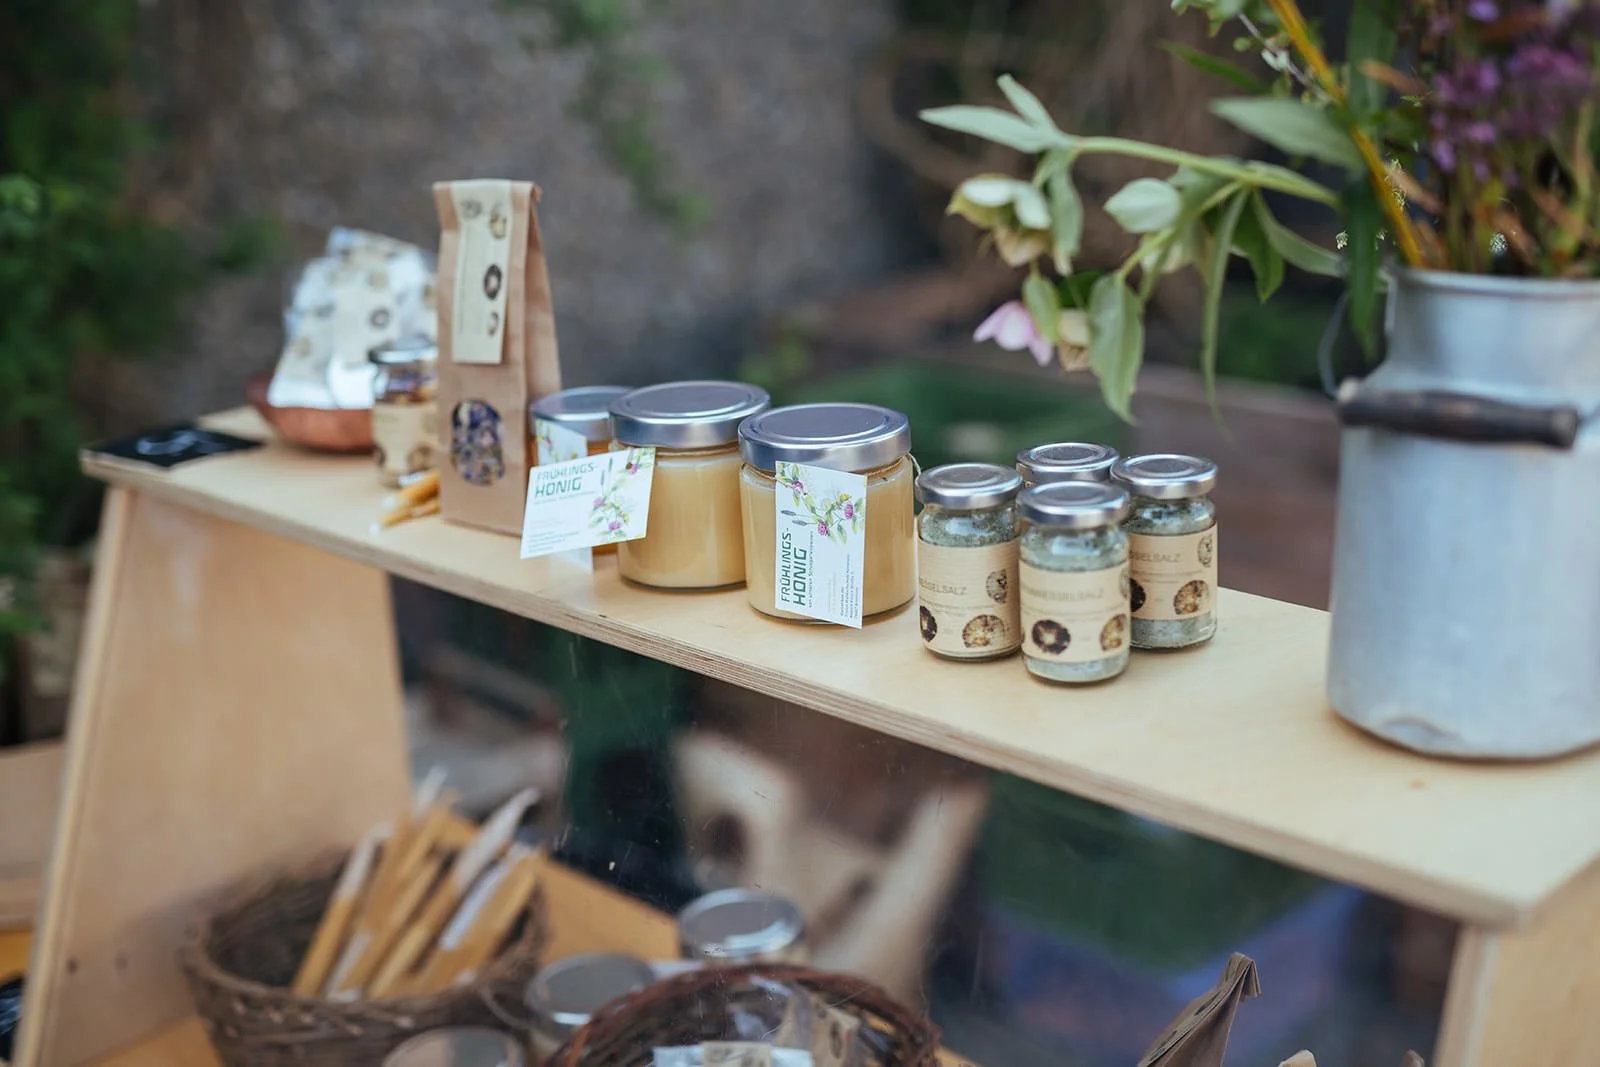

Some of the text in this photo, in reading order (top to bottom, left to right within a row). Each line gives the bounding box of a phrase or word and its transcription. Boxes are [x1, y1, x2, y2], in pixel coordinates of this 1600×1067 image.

[535, 476, 583, 498] HONIG
[780, 527, 792, 603] FRÜHLINGS-
[793, 547, 808, 607] HONIG
